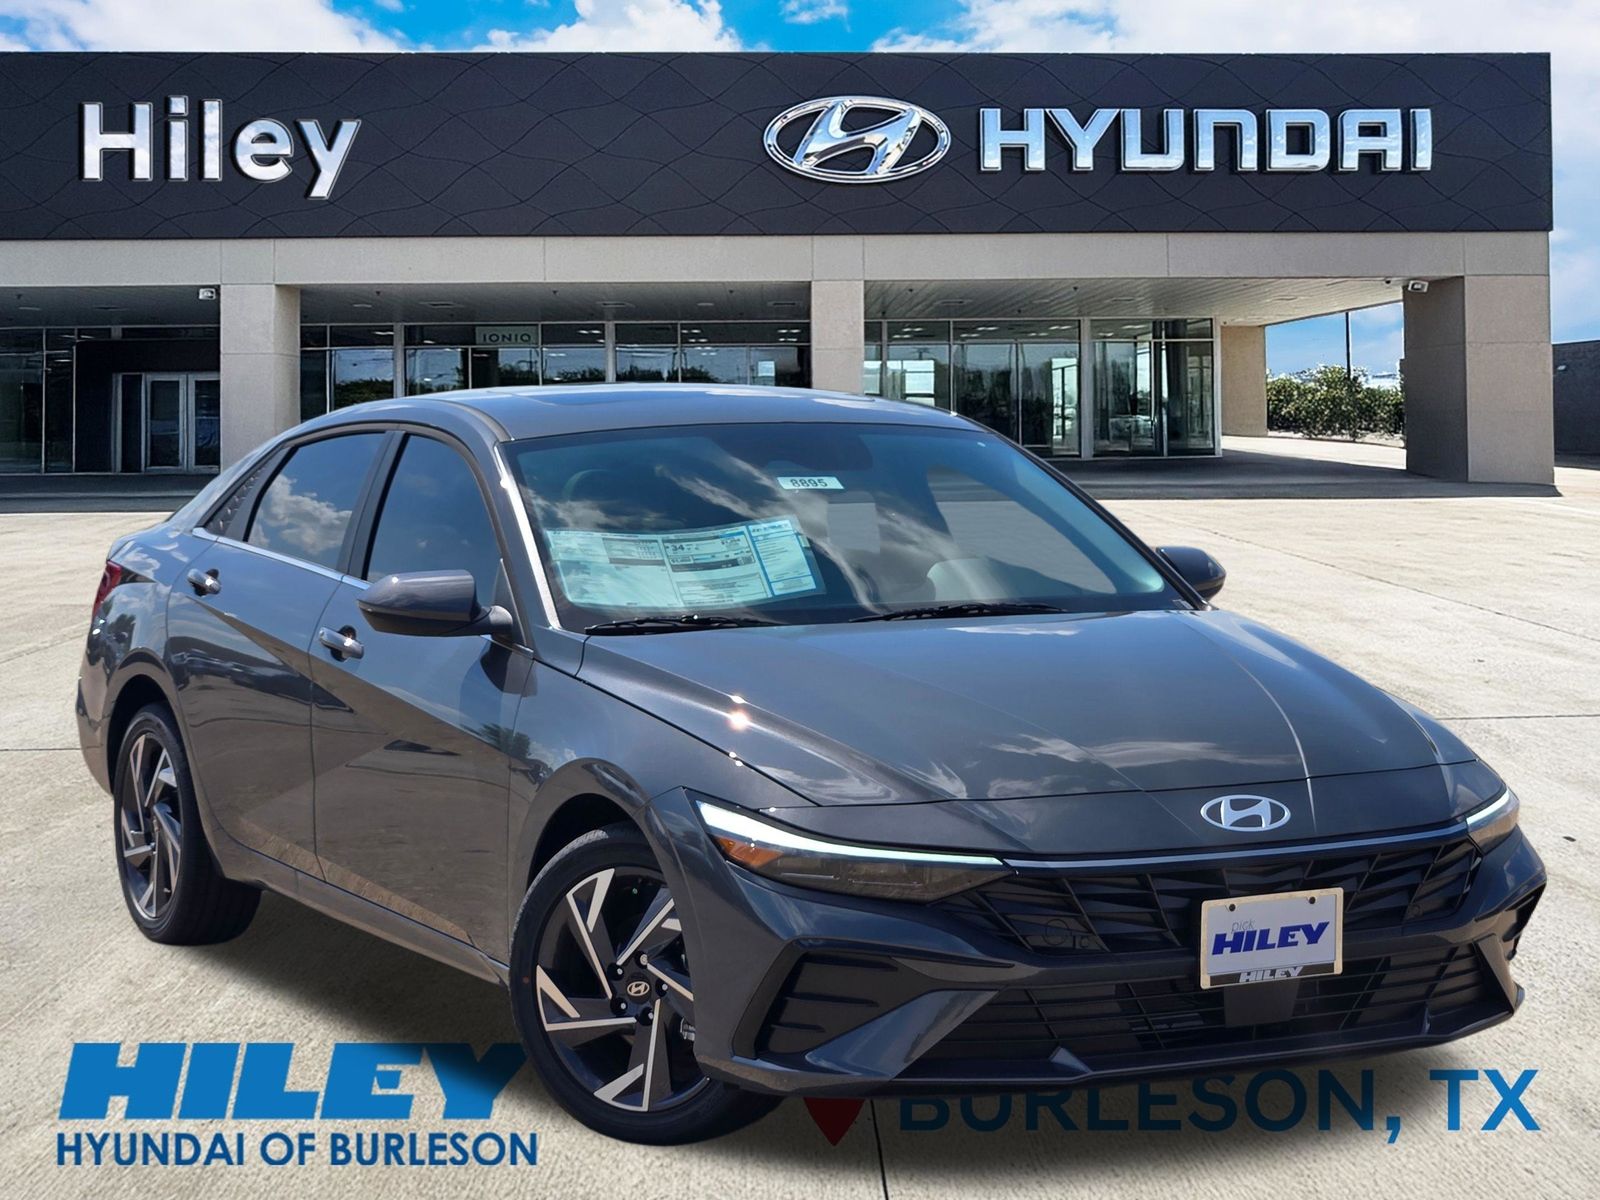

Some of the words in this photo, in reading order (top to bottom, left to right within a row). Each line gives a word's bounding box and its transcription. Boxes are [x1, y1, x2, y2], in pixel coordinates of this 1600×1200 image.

[80, 95, 361, 199] Hiley
[979, 107, 1433, 173] HYUNDAI
[790, 478, 828, 488] 8895
[1212, 921, 1330, 956] HILEY
[1239, 966, 1304, 984] HILEY
